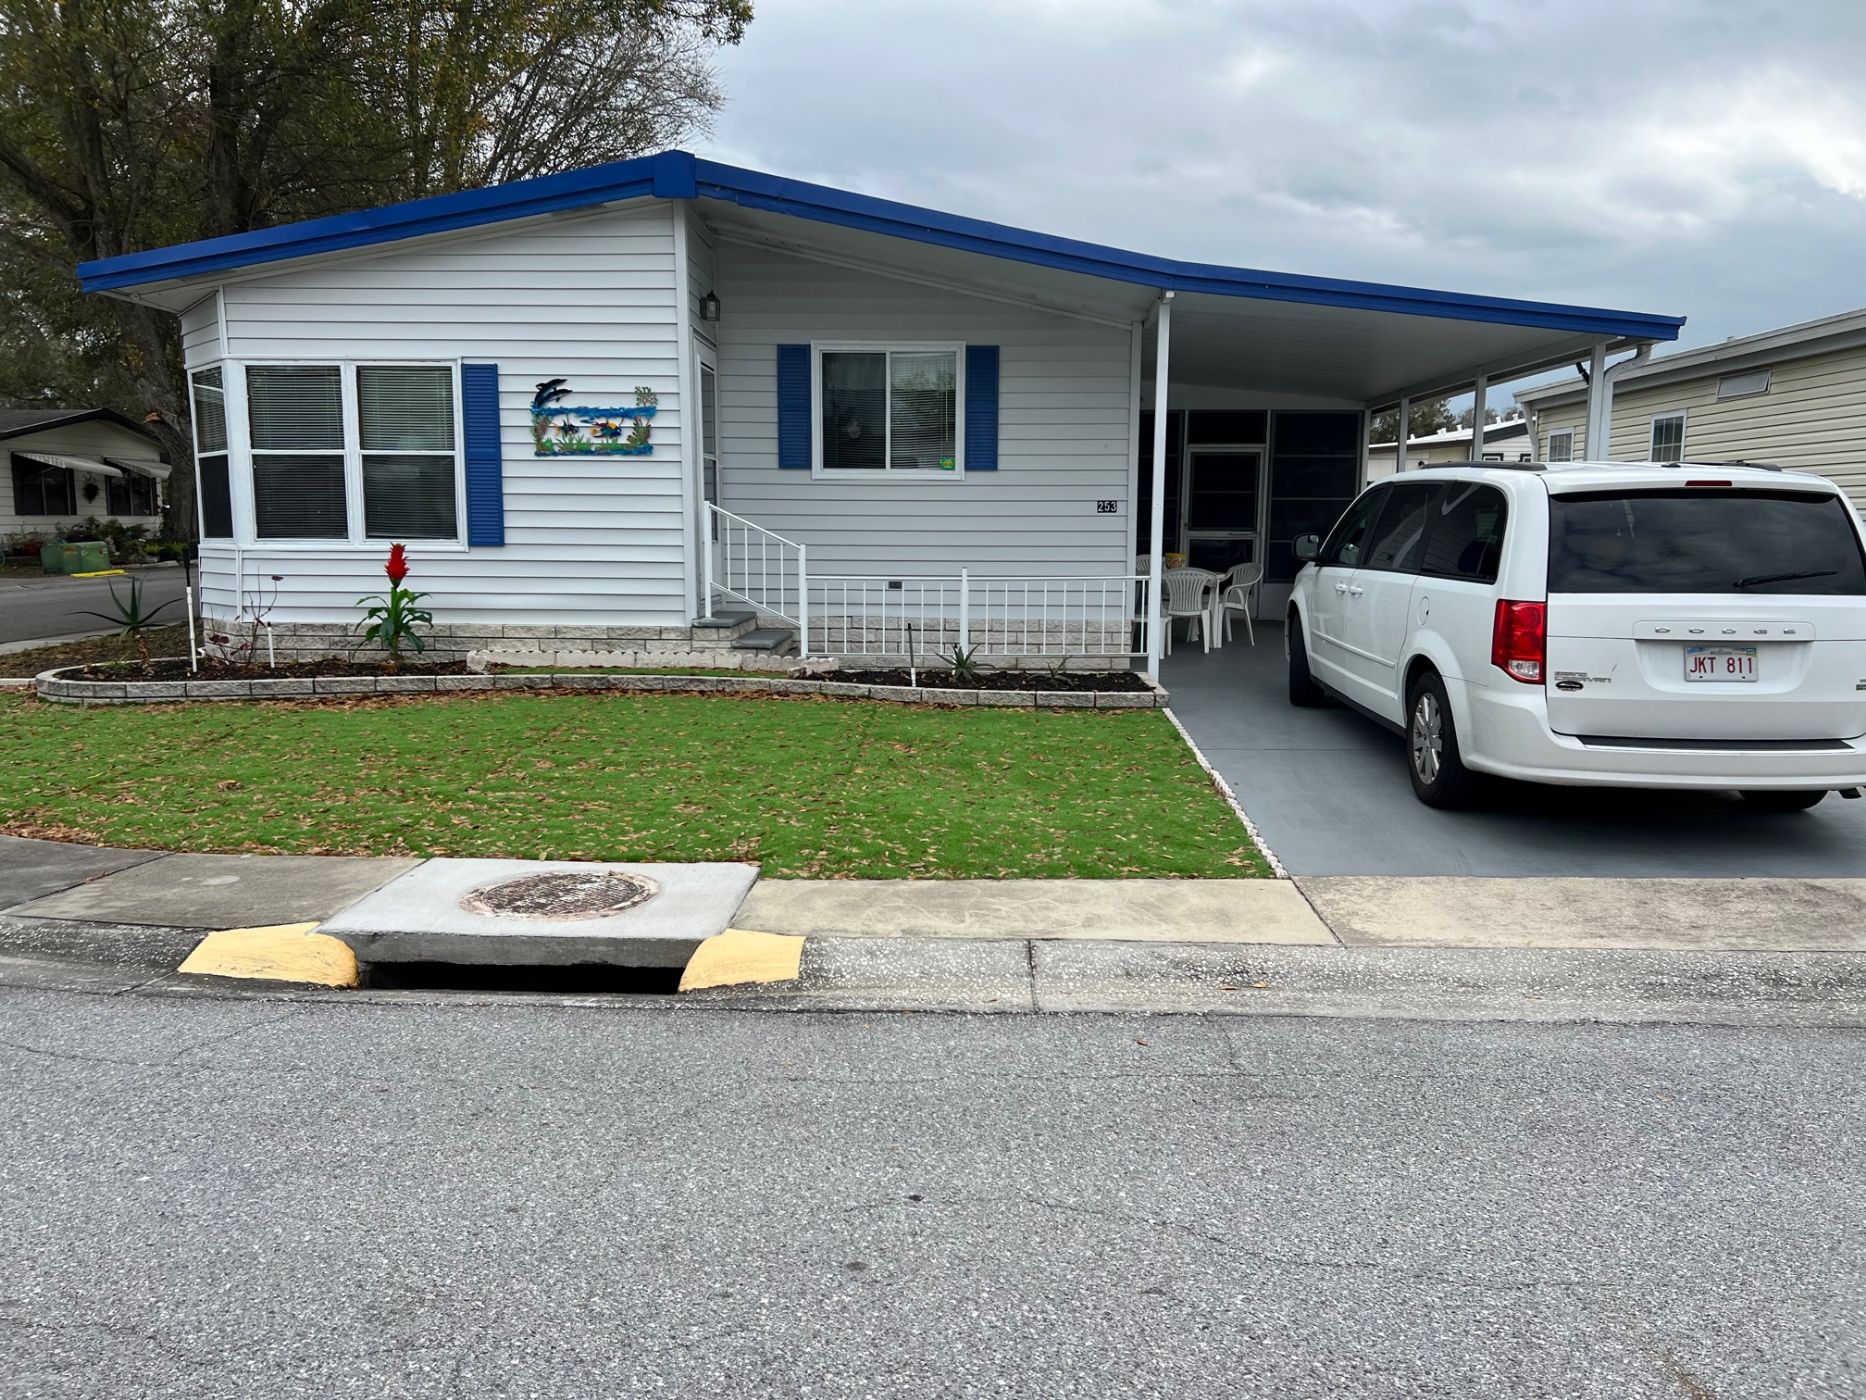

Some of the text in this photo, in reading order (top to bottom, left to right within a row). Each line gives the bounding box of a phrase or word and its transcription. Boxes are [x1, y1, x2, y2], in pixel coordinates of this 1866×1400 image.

[1098, 501, 1117, 512] 253
[1689, 656, 1753, 674] JKT 811
